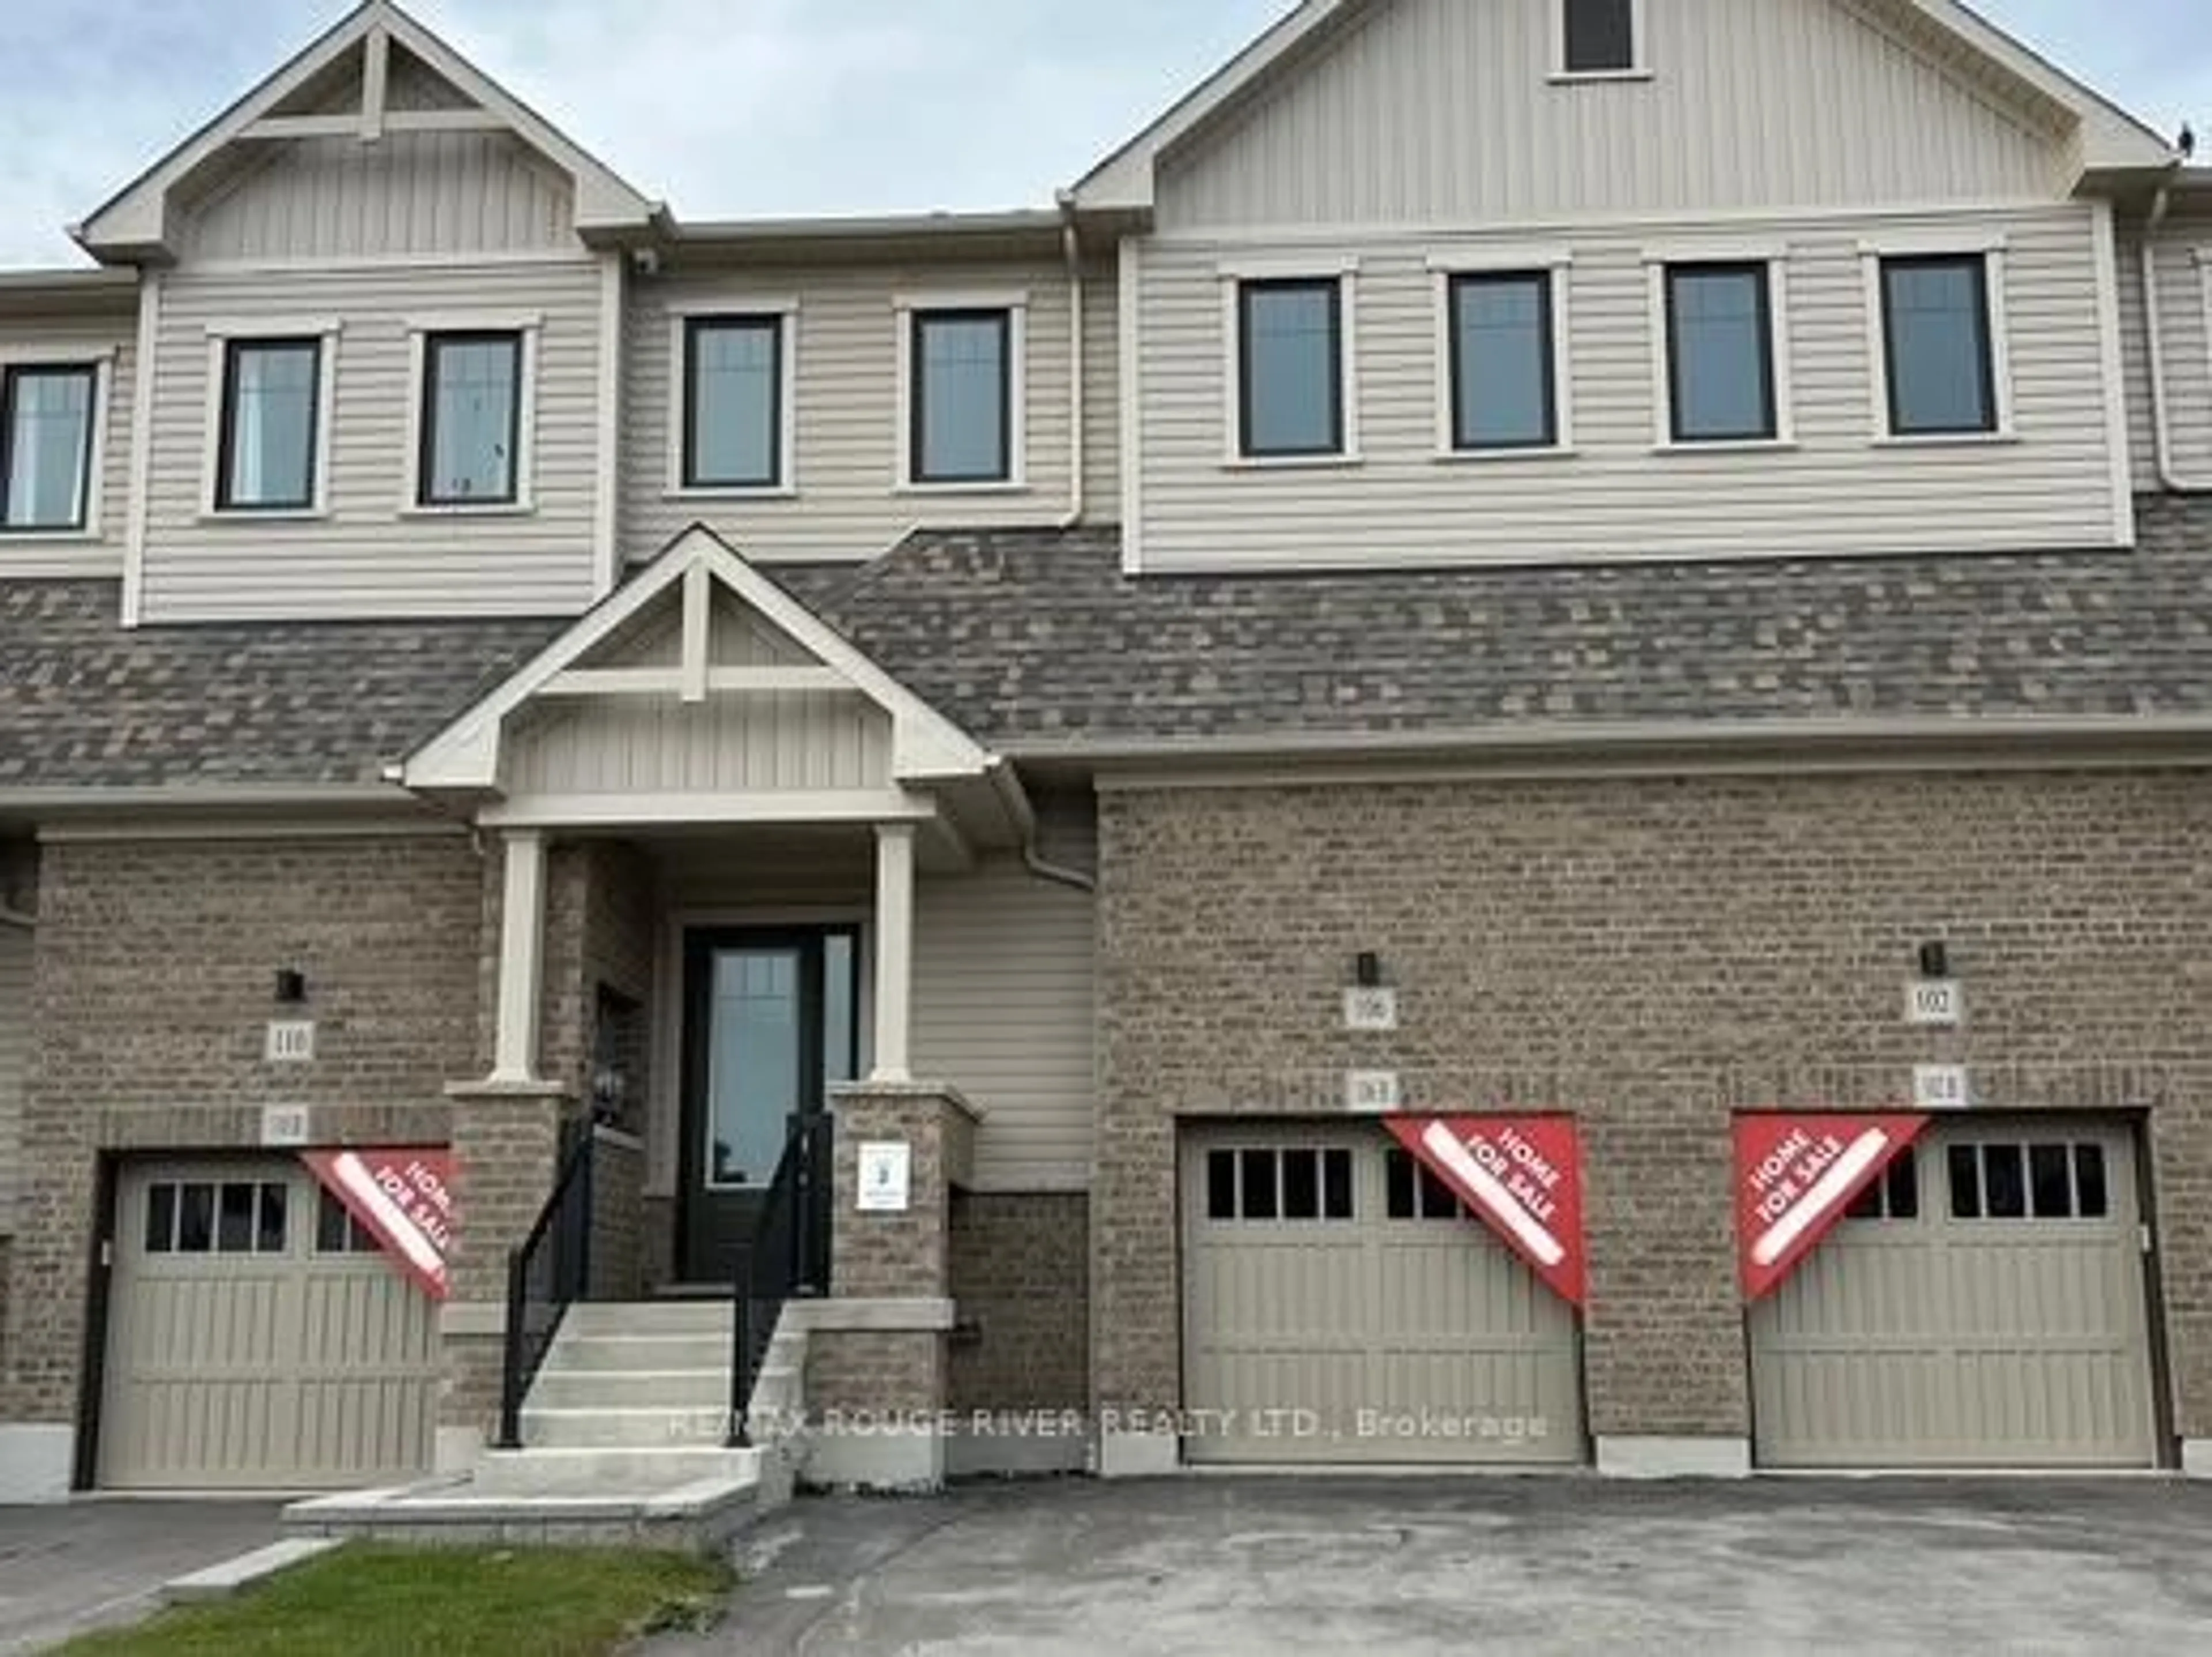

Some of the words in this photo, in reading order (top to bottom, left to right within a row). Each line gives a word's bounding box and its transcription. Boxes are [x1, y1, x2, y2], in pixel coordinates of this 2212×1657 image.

[375, 1165, 416, 1206] FOR
[404, 1160, 451, 1212] HOM
[1468, 1134, 1509, 1176] FOR
[1508, 1172, 1555, 1221] SALE
[1498, 1127, 1561, 1189] HOME
[1749, 1127, 1811, 1193] HOME
[1754, 1178, 1800, 1223] FOR
[1793, 1133, 1842, 1183] SALE
